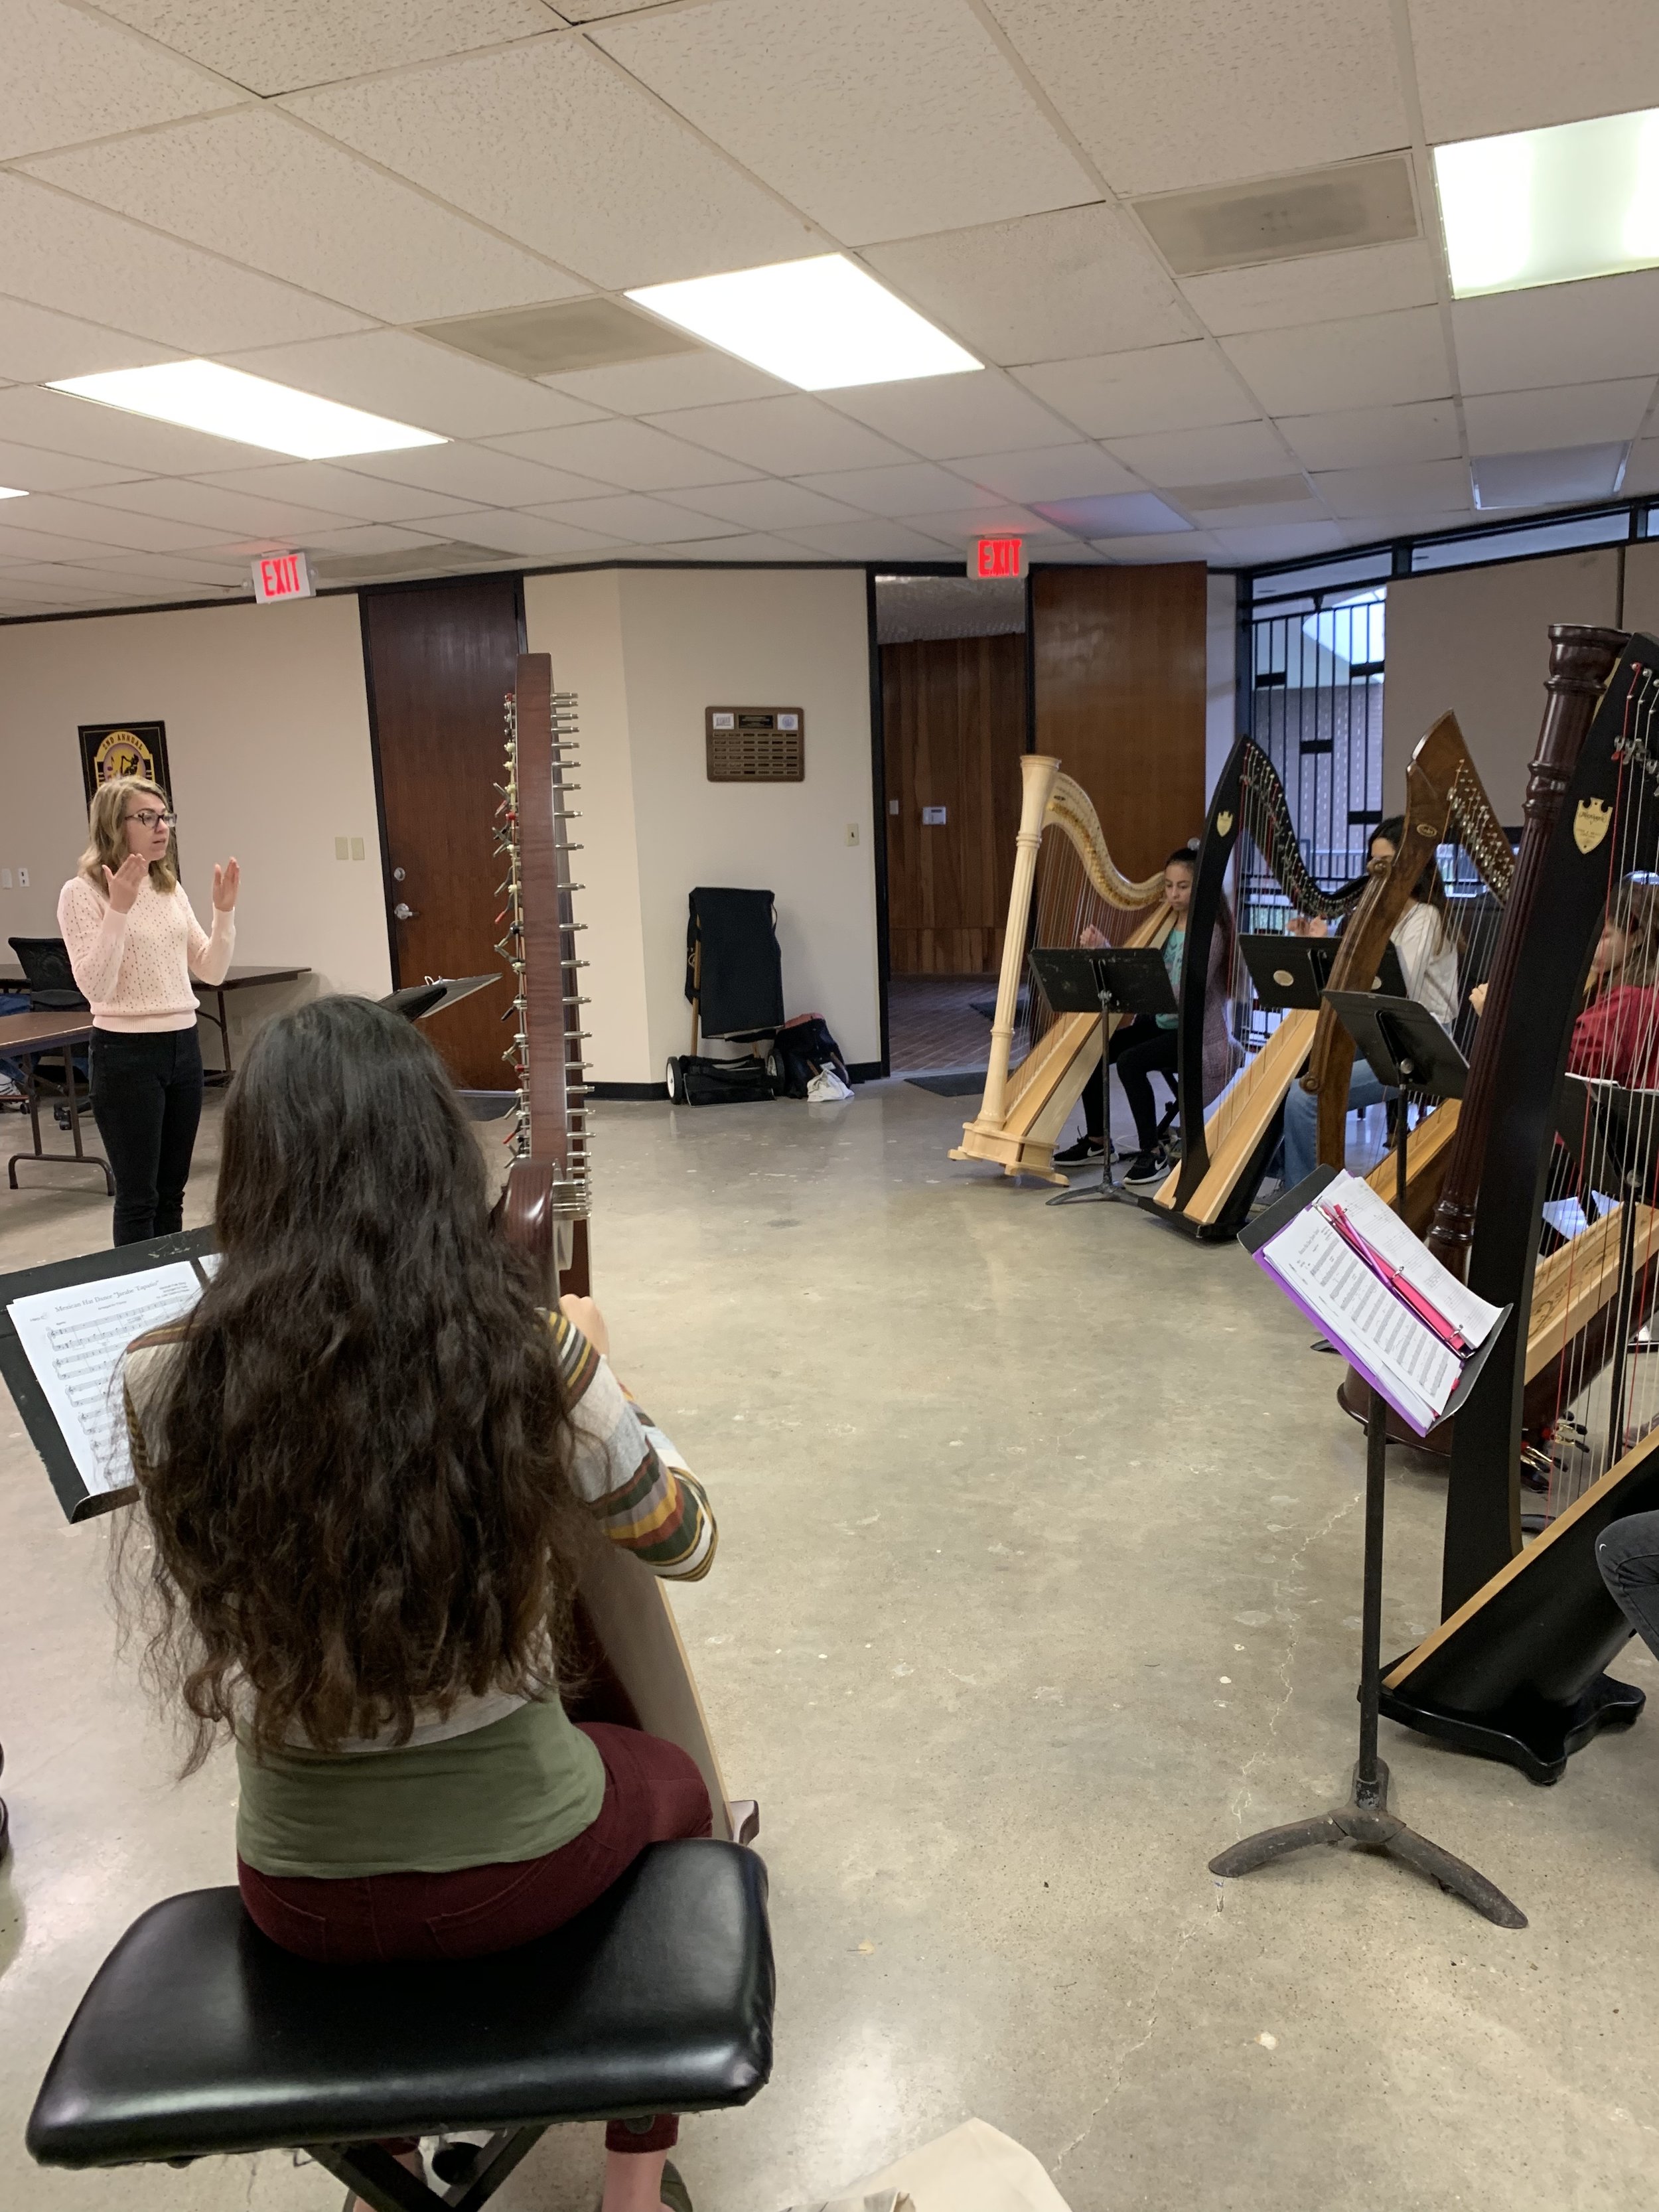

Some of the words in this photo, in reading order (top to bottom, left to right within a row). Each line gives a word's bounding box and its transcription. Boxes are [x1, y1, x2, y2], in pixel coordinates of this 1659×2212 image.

[978, 539, 1022, 577] EXIT
[261, 555, 300, 597] EXIT
[103, 737, 114, 750] 2ND
[117, 733, 143, 750] ANNUAL
[54, 1302, 82, 1313] Mexican
[94, 1294, 112, 1303] Dance
